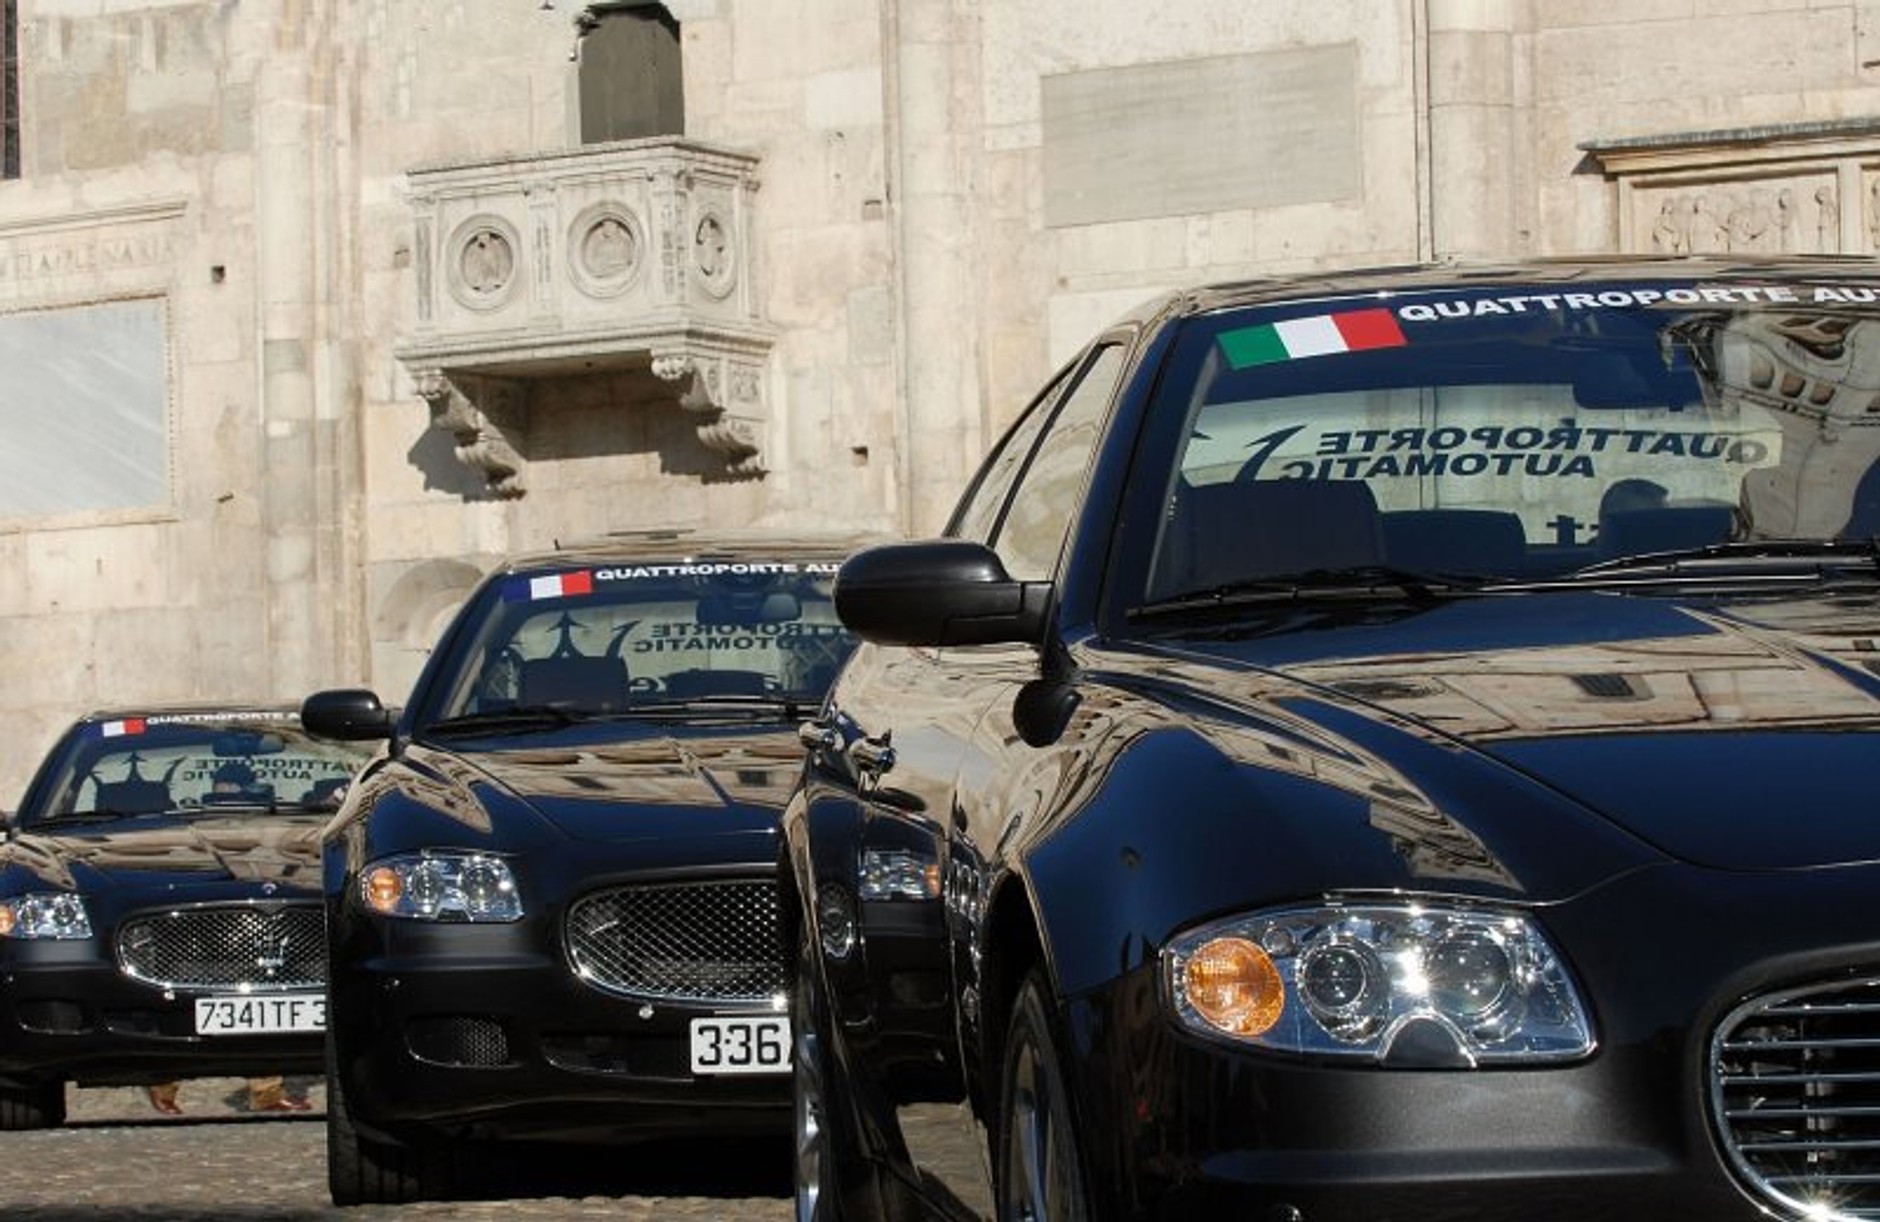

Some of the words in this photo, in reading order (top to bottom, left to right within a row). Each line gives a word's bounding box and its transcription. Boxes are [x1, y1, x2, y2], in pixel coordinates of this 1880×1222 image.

[1398, 286, 1799, 321] QUATTROPORTE
[1814, 286, 1880, 303] AU
[595, 562, 798, 580] QUATTROPORTE
[146, 711, 283, 726] QUATTROPORTE
[698, 1024, 791, 1066] 336
